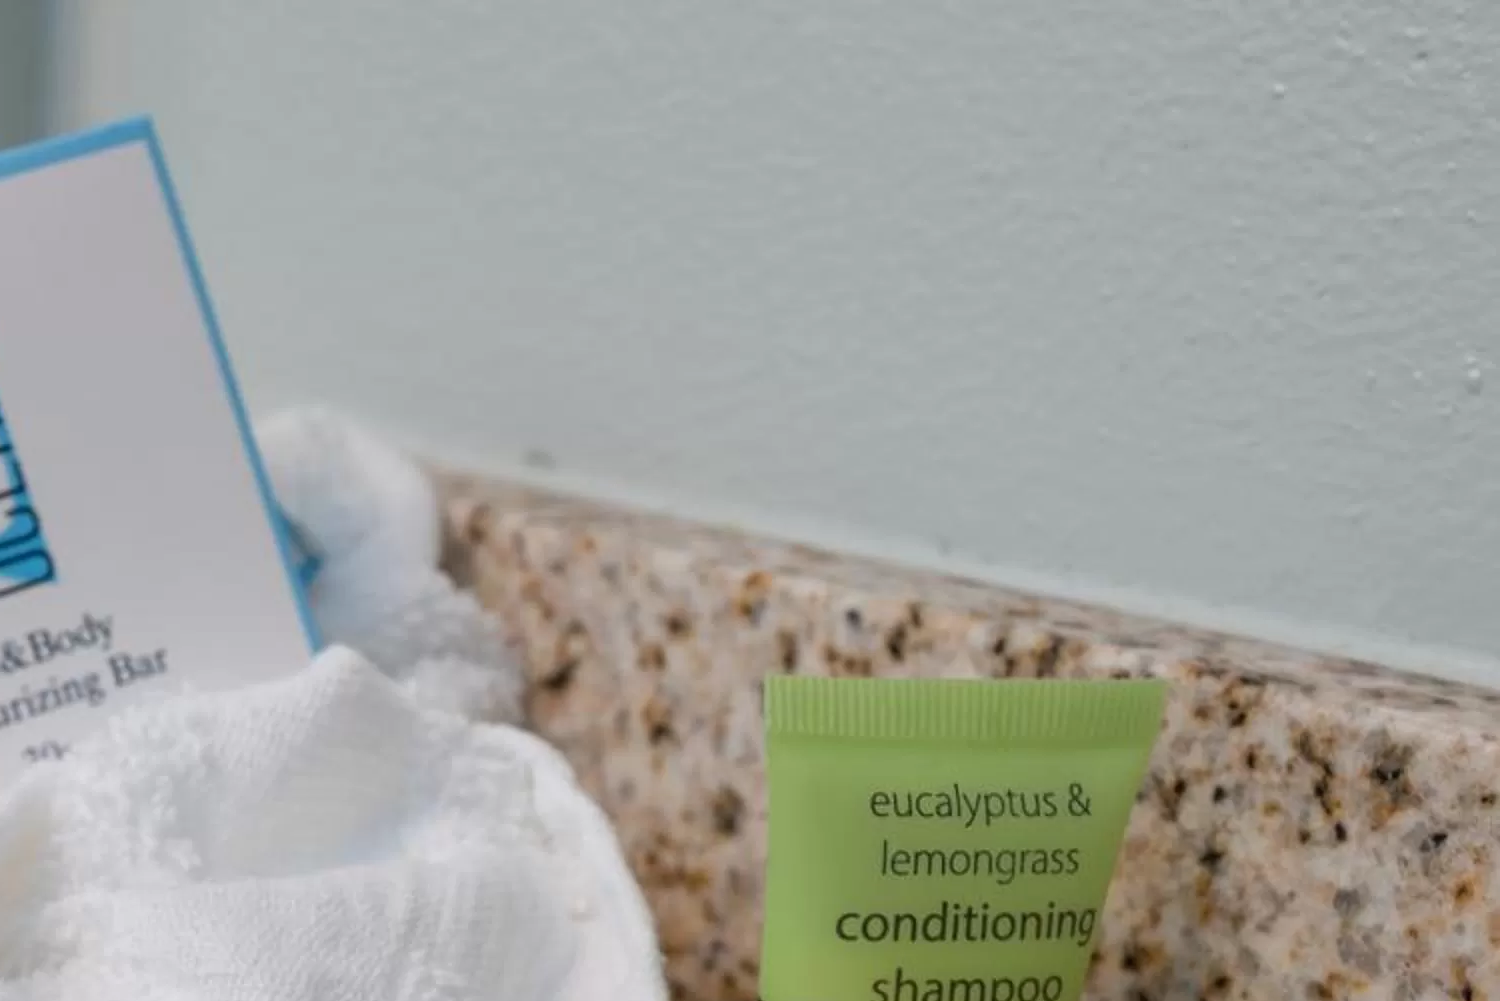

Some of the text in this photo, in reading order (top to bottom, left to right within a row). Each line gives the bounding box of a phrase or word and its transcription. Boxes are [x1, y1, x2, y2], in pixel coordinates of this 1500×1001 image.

[107, 648, 168, 687] Bar
[869, 783, 1091, 828] eucalyptus &
[881, 839, 1079, 885] lemongrass
[836, 901, 1097, 947] conditioning
